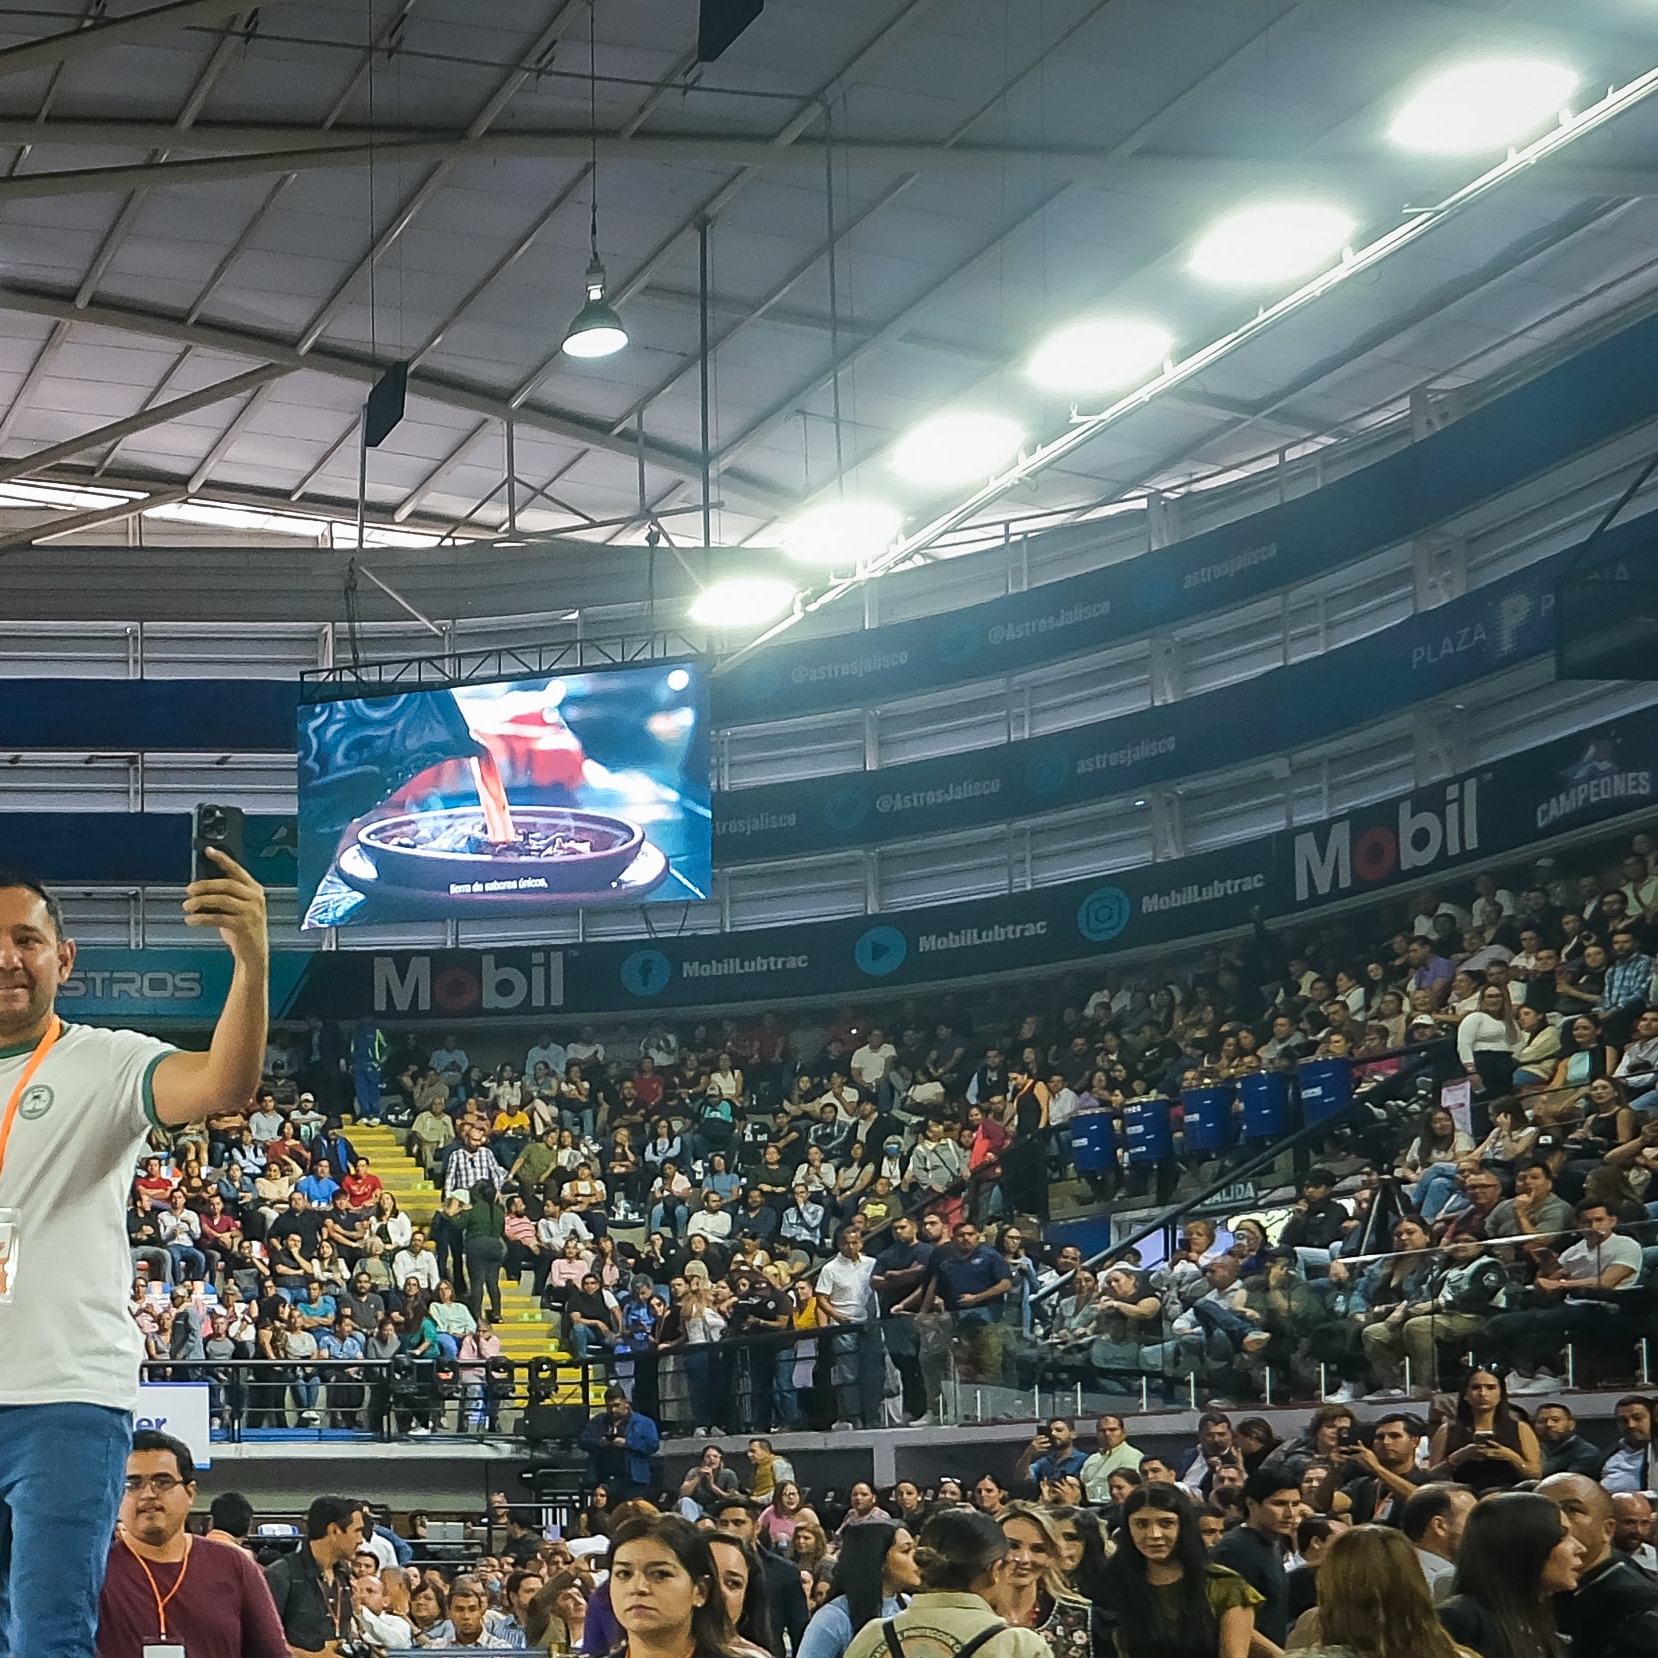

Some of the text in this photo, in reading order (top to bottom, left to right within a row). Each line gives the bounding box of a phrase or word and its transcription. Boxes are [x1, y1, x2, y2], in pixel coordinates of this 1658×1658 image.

[1412, 623, 1486, 670] PLAZA
[1076, 735, 1176, 774] astrosjalisco
[1537, 771, 1651, 828] CAMPEONES
[715, 812, 797, 836] trosjalisco
[1295, 777, 1478, 901] Mobil
[1142, 873, 1264, 914] MobilLubtrac
[918, 921, 1047, 952] MobilLubtrac
[57, 971, 203, 998] STROS
[373, 951, 564, 1011] Mobil
[682, 955, 809, 978] MobilLubtrac
[1204, 1182, 1255, 1205] ALIDA
